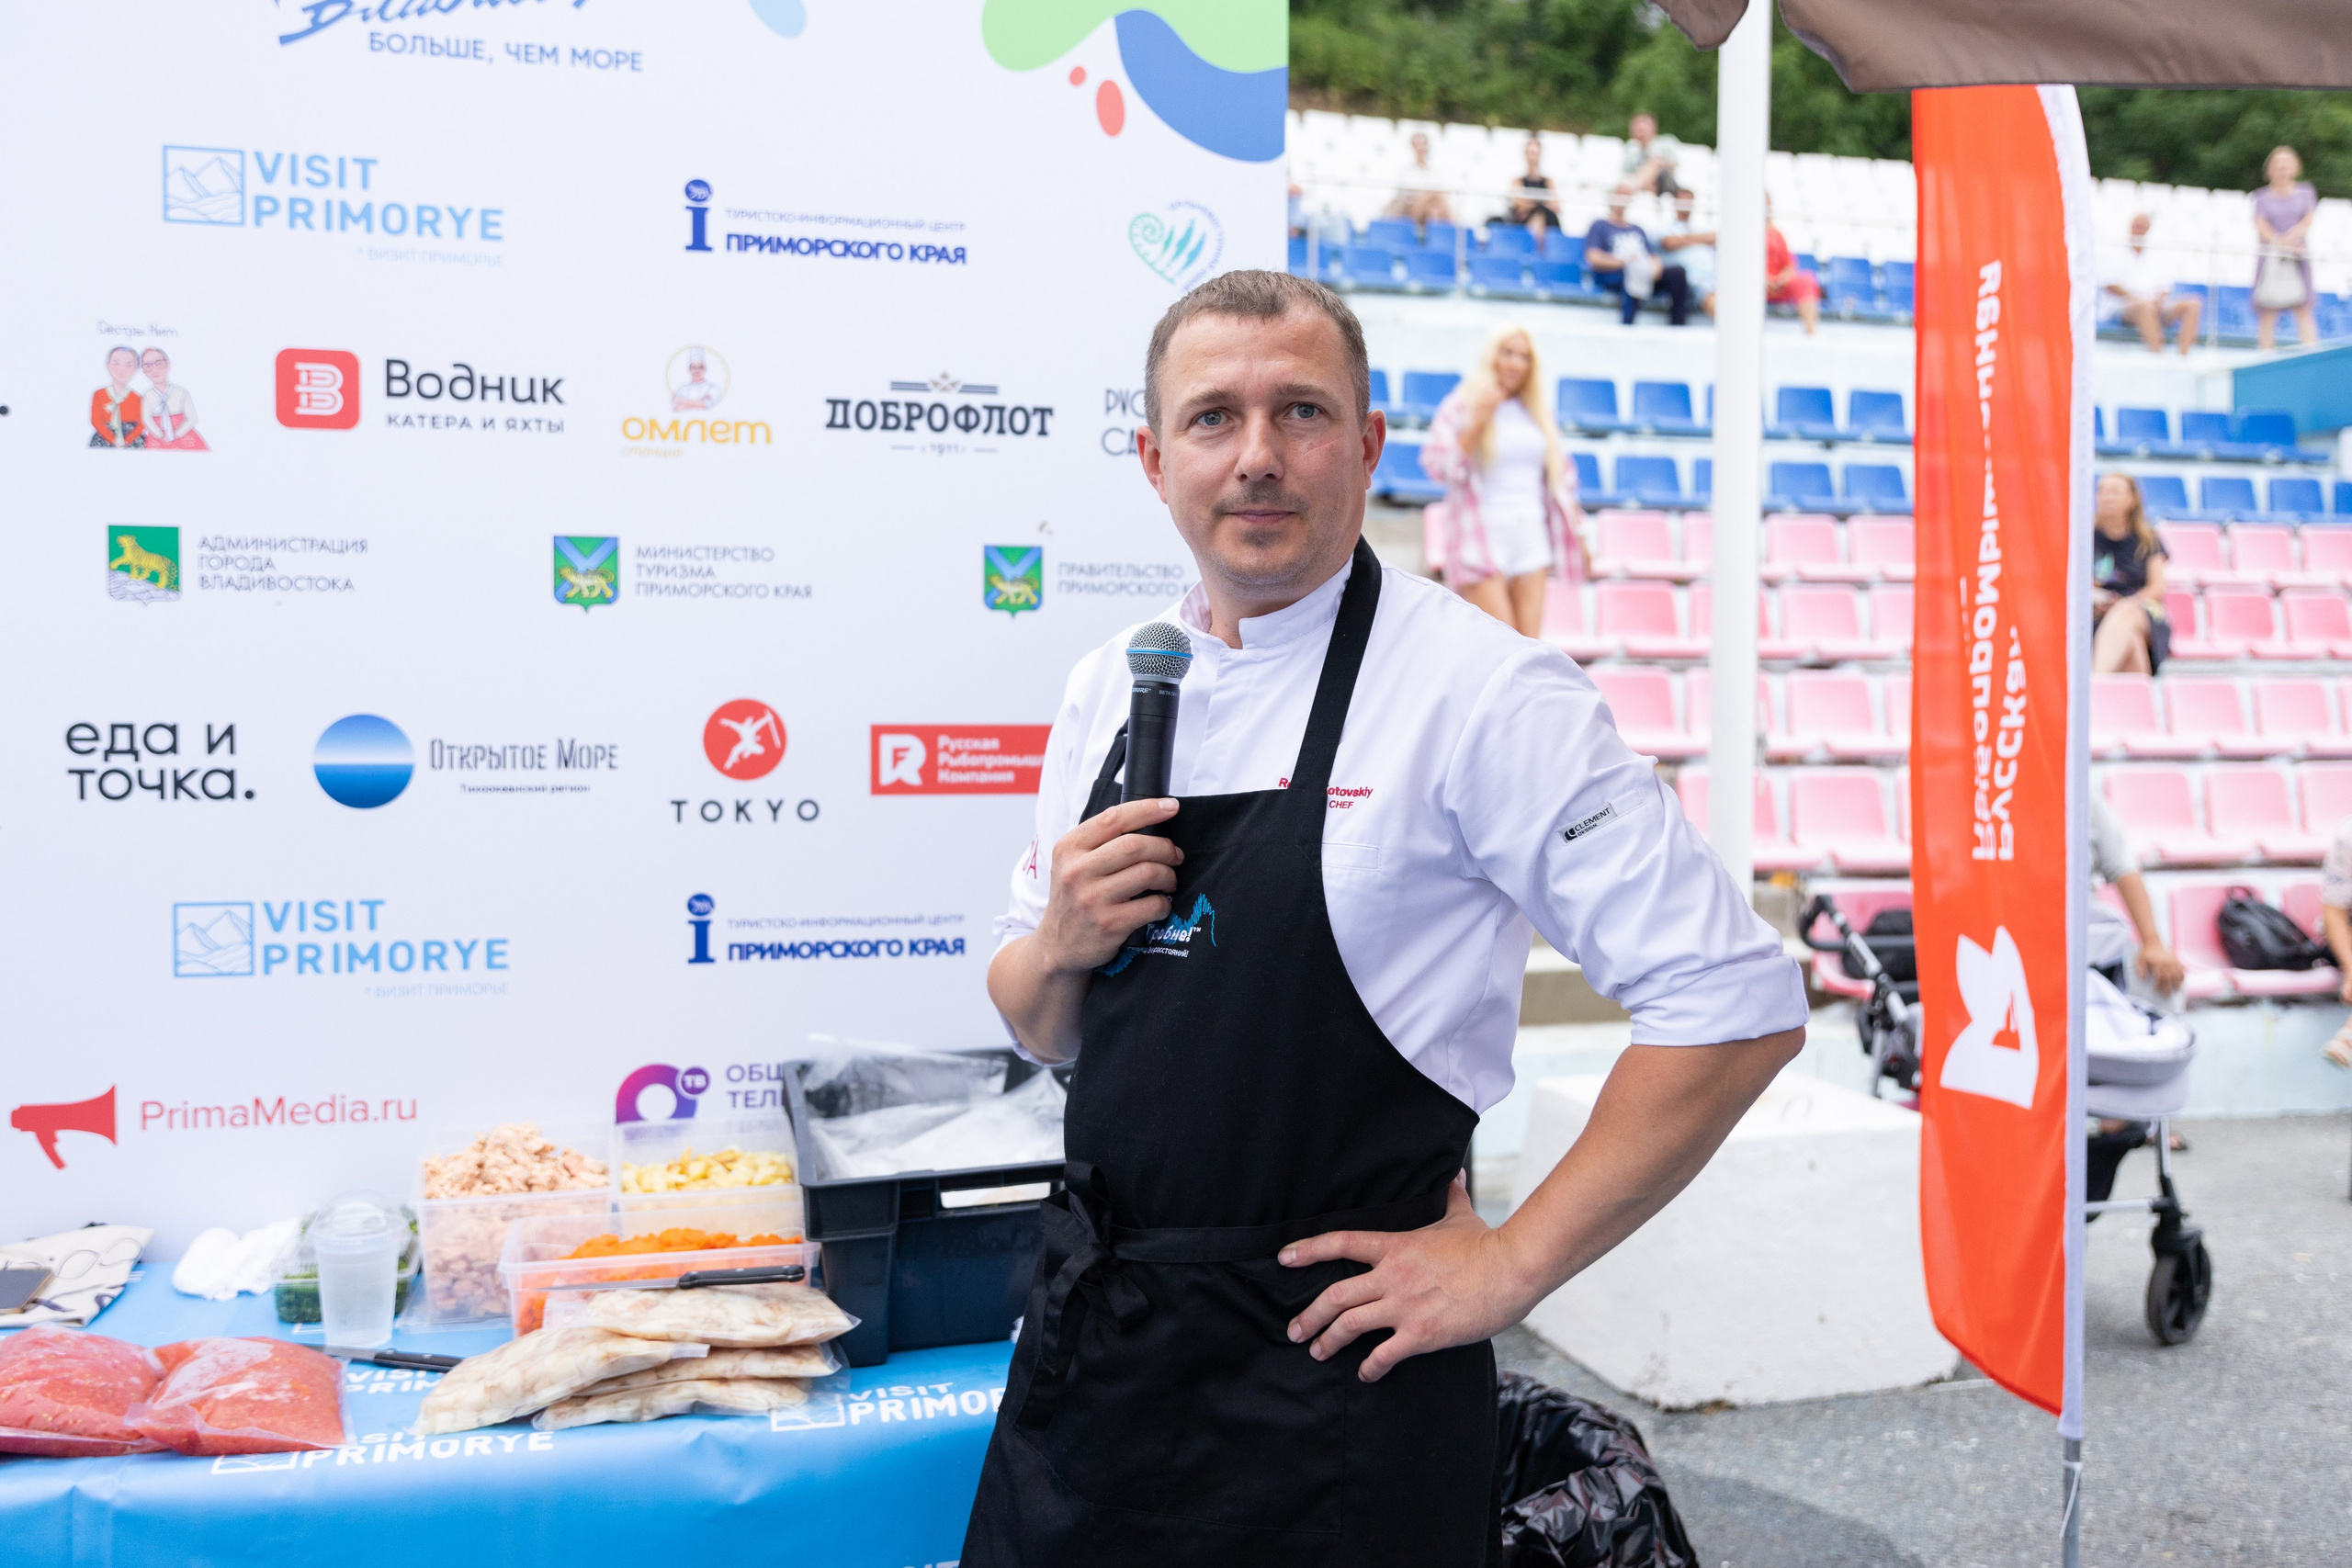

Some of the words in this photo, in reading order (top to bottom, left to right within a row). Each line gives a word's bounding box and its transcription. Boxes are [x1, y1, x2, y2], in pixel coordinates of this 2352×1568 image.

[368, 30, 494, 64] БОЛЬШЕ,
[504, 42, 560, 65] ЧЕМ
[570, 47, 643, 73] МОРЕ
[253, 150, 379, 192] VISIT
[253, 194, 504, 243] PRIMORYE
[726, 232, 905, 262] ПРИМОРСКОГО
[909, 243, 967, 265] КРАЯ
[385, 358, 564, 405] Водник
[386, 413, 473, 430] КАТЕРА
[481, 417, 496, 431] И
[504, 416, 565, 434] ЯХТЫ
[825, 398, 1055, 437] ДОБРОФЛОТ
[198, 535, 368, 558] АДМИНИСТРАЦИЯ
[636, 545, 775, 566] МИНИСТЕРСТВО
[198, 554, 277, 573] ГОРОДА
[635, 562, 717, 580] ТУРИЗМА
[1057, 561, 1185, 581] ПРАВИТЕЛЬСТВО
[198, 573, 356, 592] ВЛАДИВОСТОКА
[635, 581, 770, 600] ПРИМОРСКОГО
[773, 584, 812, 599] КРАЯ
[1057, 579, 1180, 597] ПРИМОРСКОГО
[64, 722, 179, 763] еда
[206, 723, 235, 756] и
[67, 767, 255, 802] точка.
[670, 798, 820, 824] TOKYO
[1329, 800, 1354, 809] CHEF
[1574, 807, 1611, 832] CLEMENT
[262, 898, 386, 934] VISIT
[262, 938, 509, 976] PRIMORYE
[728, 938, 905, 962] ПРИМОРСКОГО
[908, 937, 966, 957] КРАЯ
[140, 1093, 418, 1132] PrimaMedia.ru
[849, 1382, 953, 1401] VISIT
[301, 1429, 555, 1470] PRIMORYE
